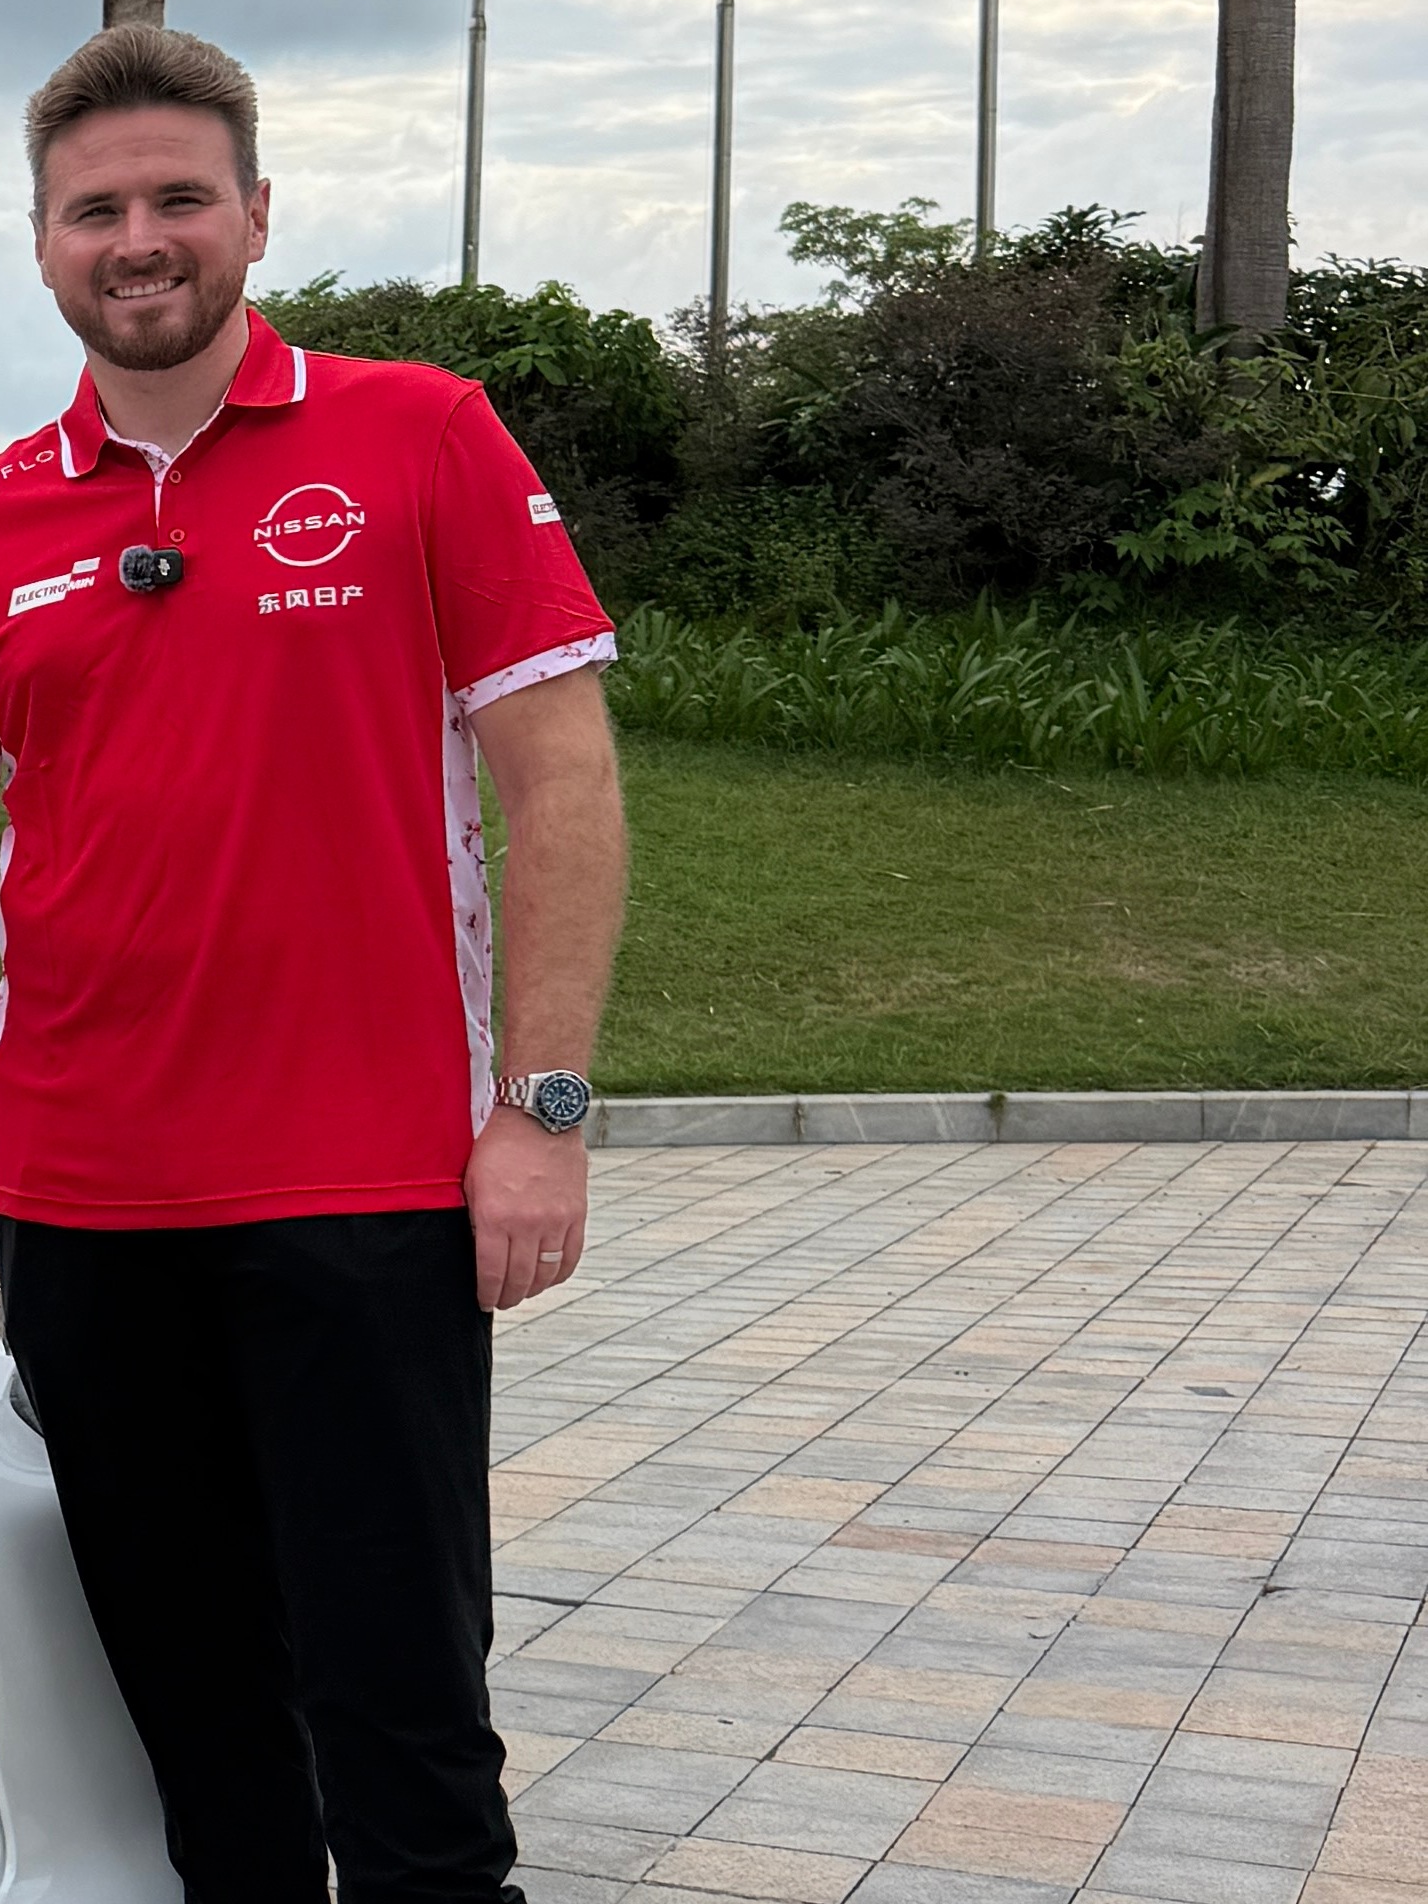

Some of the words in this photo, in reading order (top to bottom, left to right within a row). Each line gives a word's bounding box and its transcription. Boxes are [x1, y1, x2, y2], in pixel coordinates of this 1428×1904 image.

[253, 511, 365, 541] NISSAN
[15, 575, 95, 606] ELECTROMIN
[257, 584, 364, 615] 东风日产
